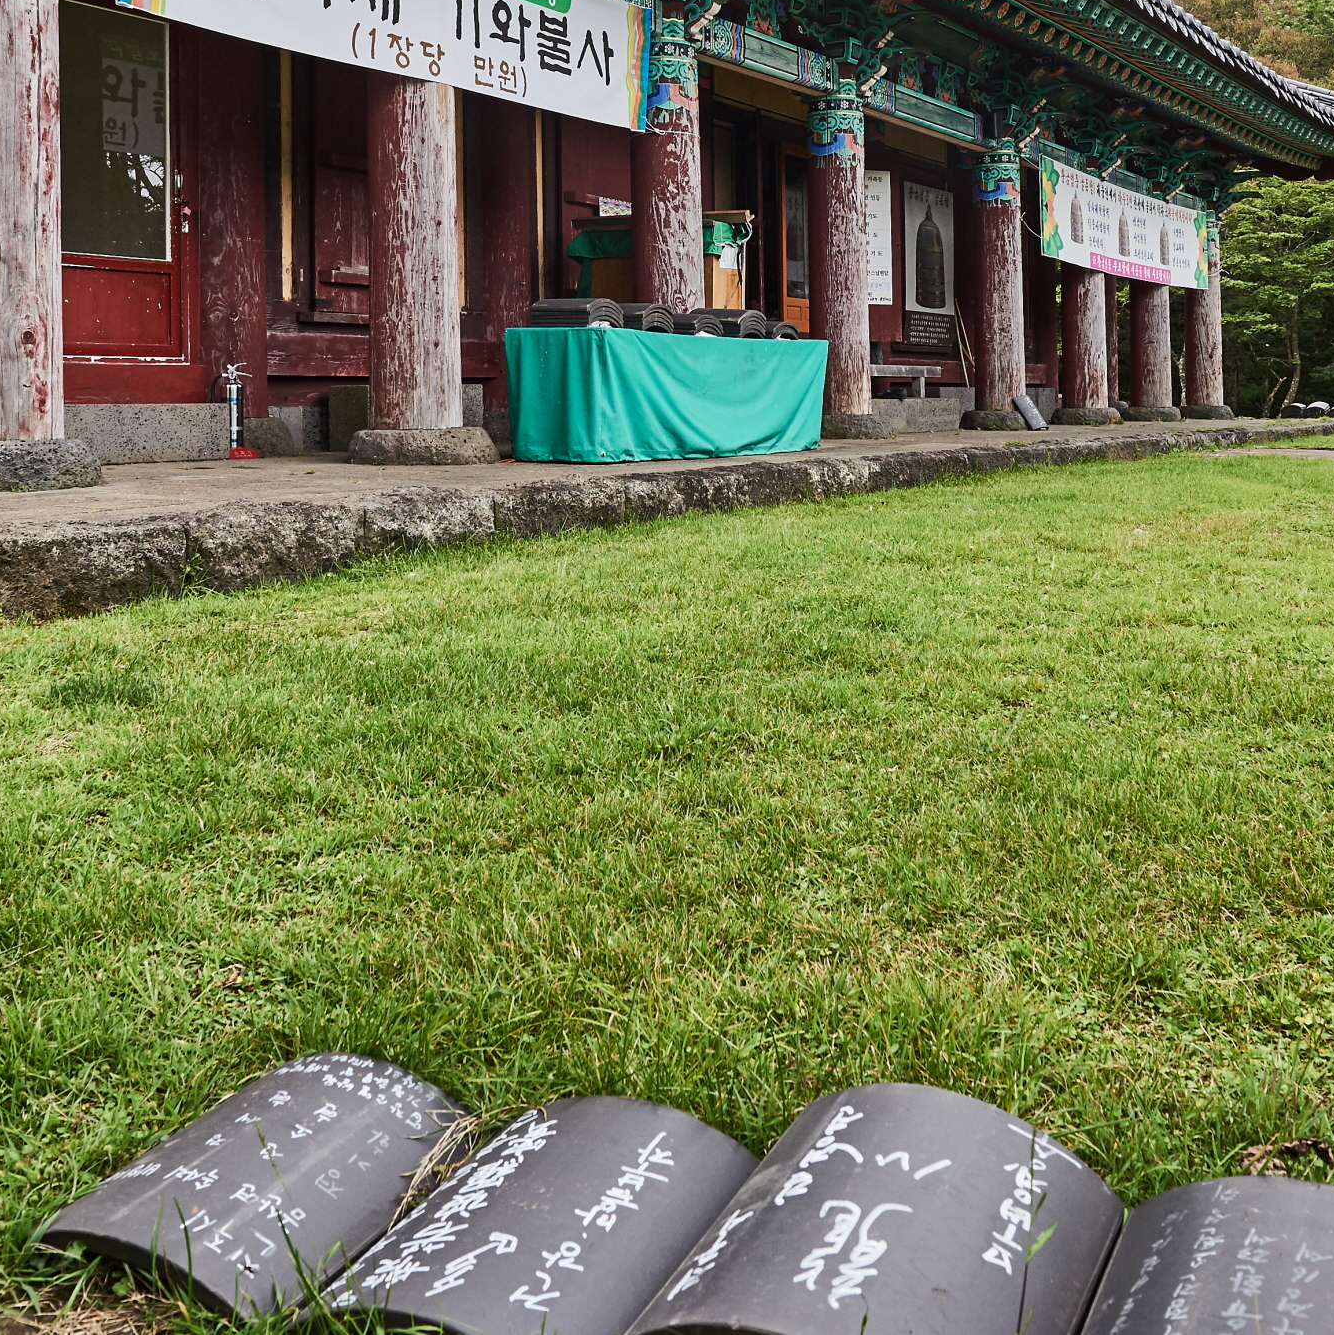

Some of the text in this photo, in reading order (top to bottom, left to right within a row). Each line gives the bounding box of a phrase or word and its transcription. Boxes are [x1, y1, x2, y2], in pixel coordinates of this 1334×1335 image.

[351, 22, 529, 98] (1장당 만원)
[180, 1210, 275, 1278] 진주시
